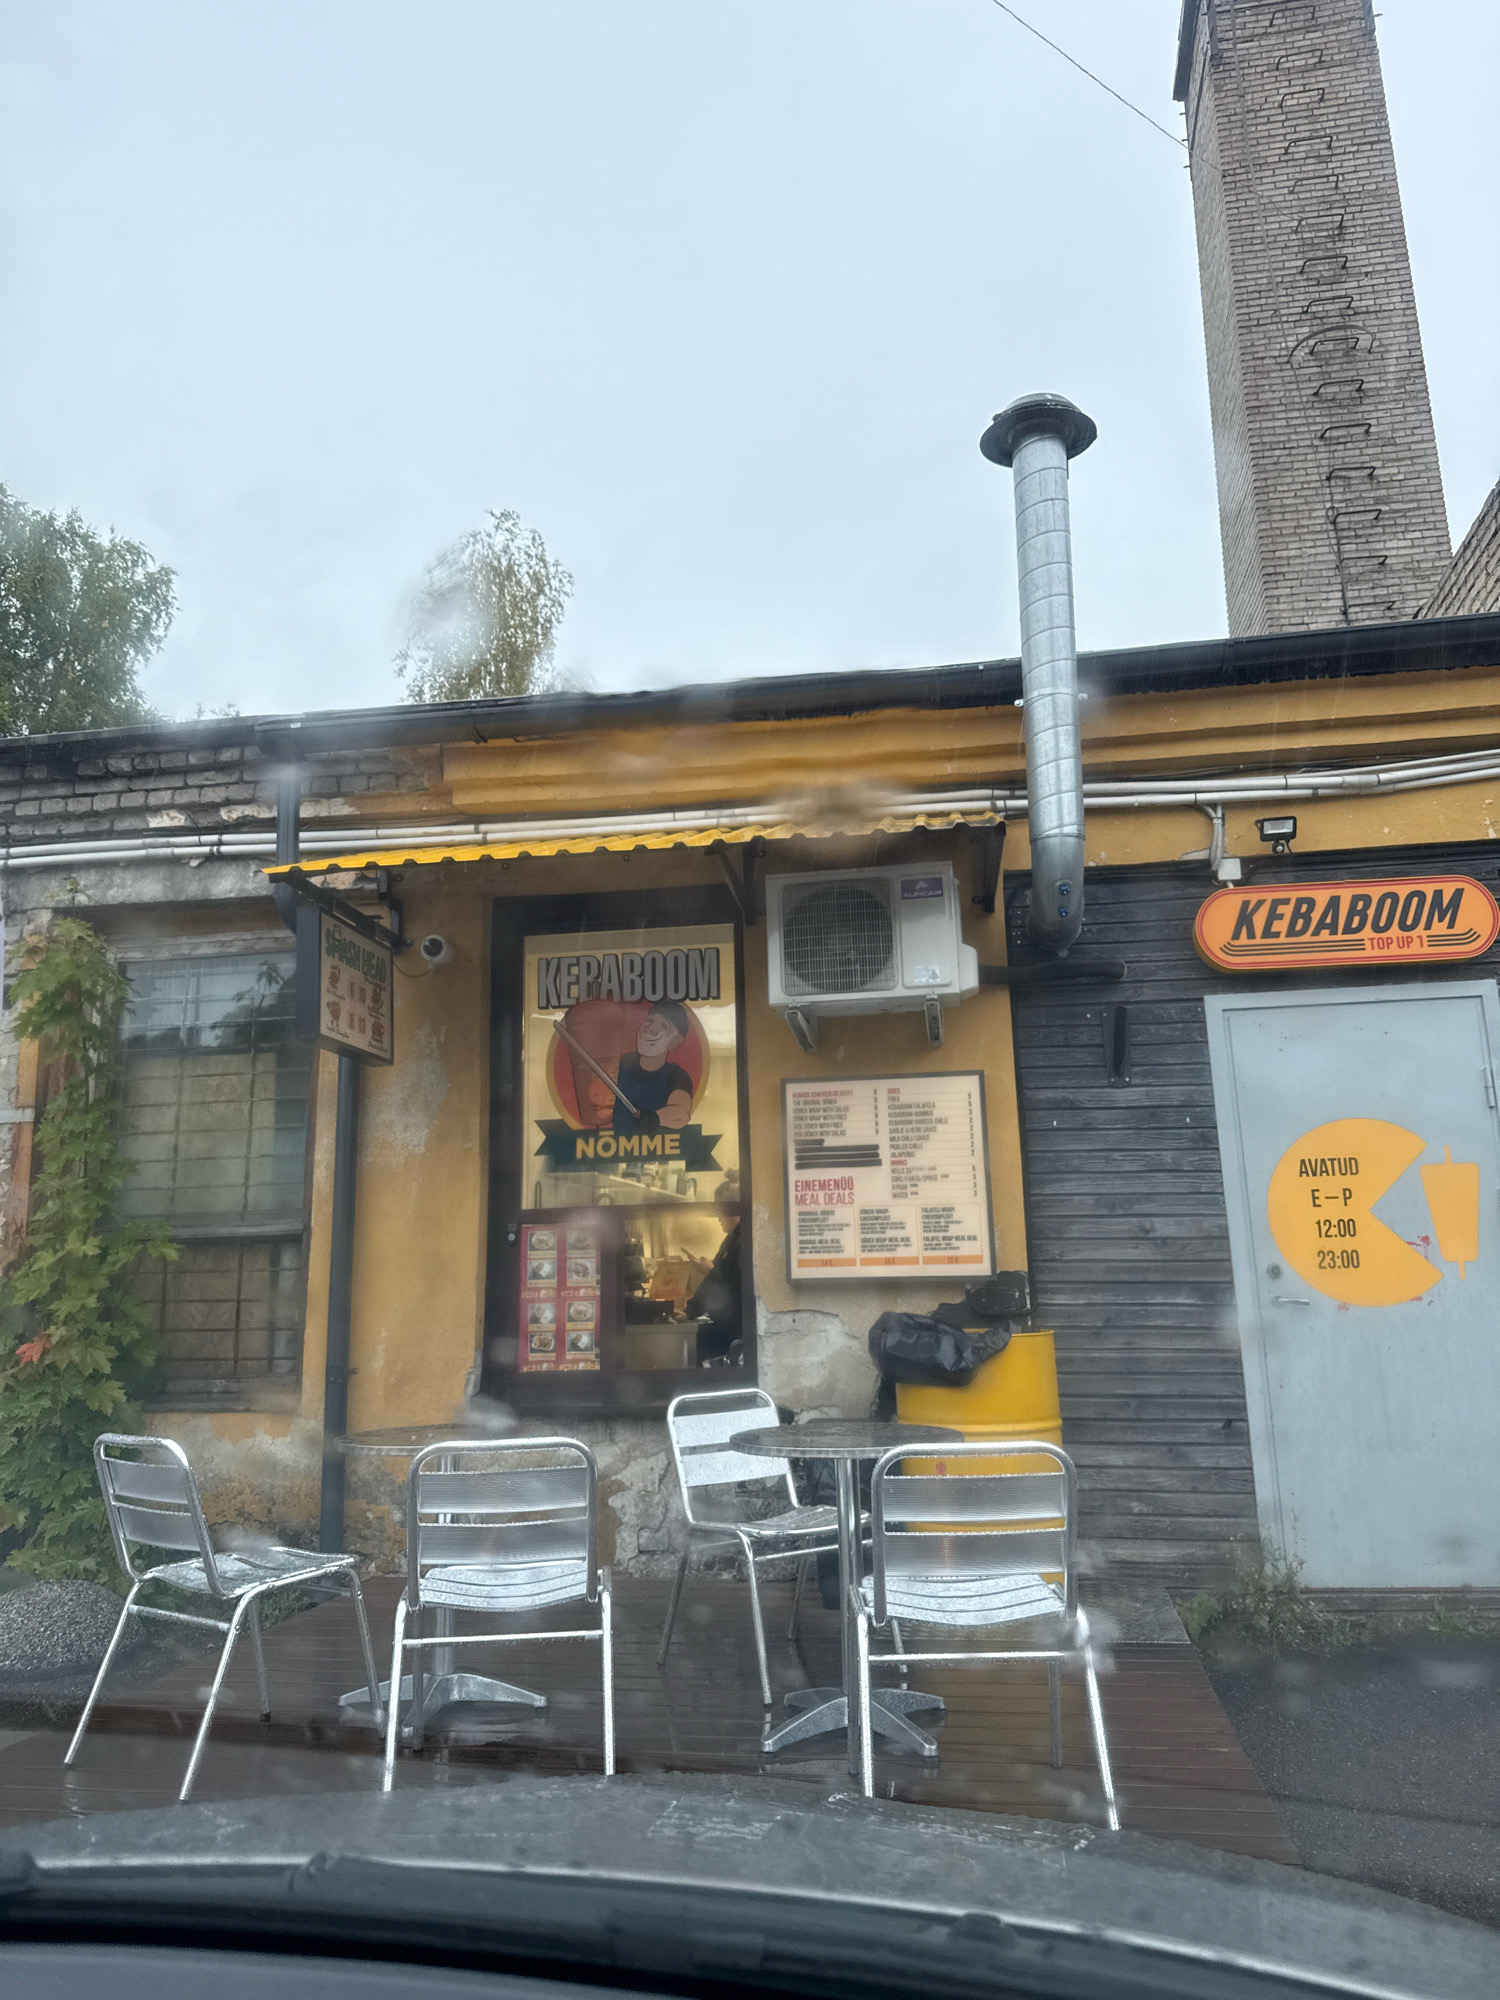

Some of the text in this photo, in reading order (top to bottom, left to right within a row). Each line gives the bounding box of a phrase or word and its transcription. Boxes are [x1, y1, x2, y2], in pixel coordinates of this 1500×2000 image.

[1231, 888, 1465, 941] KEBABOOM
[1367, 936, 1424, 951] TOP UP 1
[537, 947, 721, 1010] KEBABOOM
[1299, 1157, 1359, 1177] AVATUD
[795, 1176, 854, 1192] EINEMENÜÜ
[795, 1192, 854, 1206] MEAL DEALS
[1311, 1188, 1321, 1207] E
[1342, 1188, 1353, 1206] P
[1315, 1218, 1357, 1238] 12:00
[1317, 1249, 1360, 1270] 23:00
